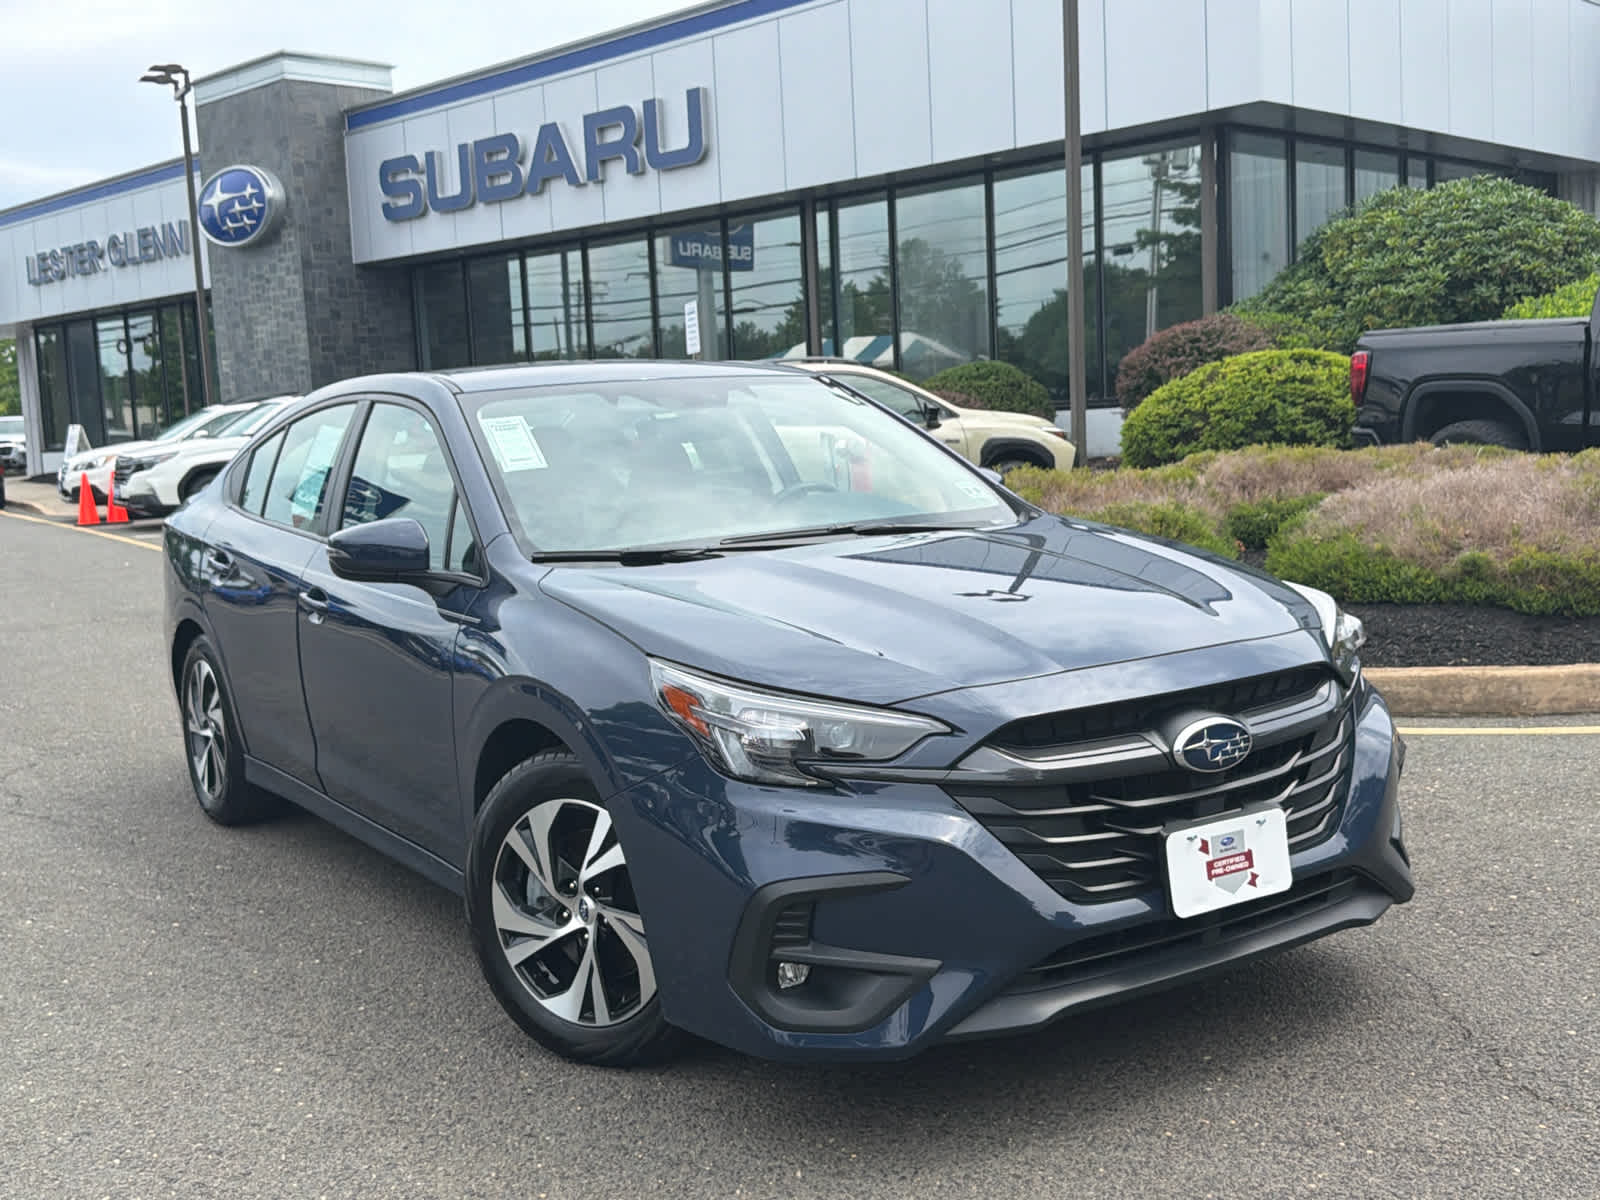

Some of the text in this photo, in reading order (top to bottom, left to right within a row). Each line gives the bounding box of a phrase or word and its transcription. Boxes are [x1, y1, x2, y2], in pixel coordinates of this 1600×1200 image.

[379, 87, 706, 222] SUBARU
[25, 219, 190, 286] LESTER GLENN
[1211, 861, 1250, 876] PRE-OWNED
[1213, 855, 1246, 868] CERTIFIED
